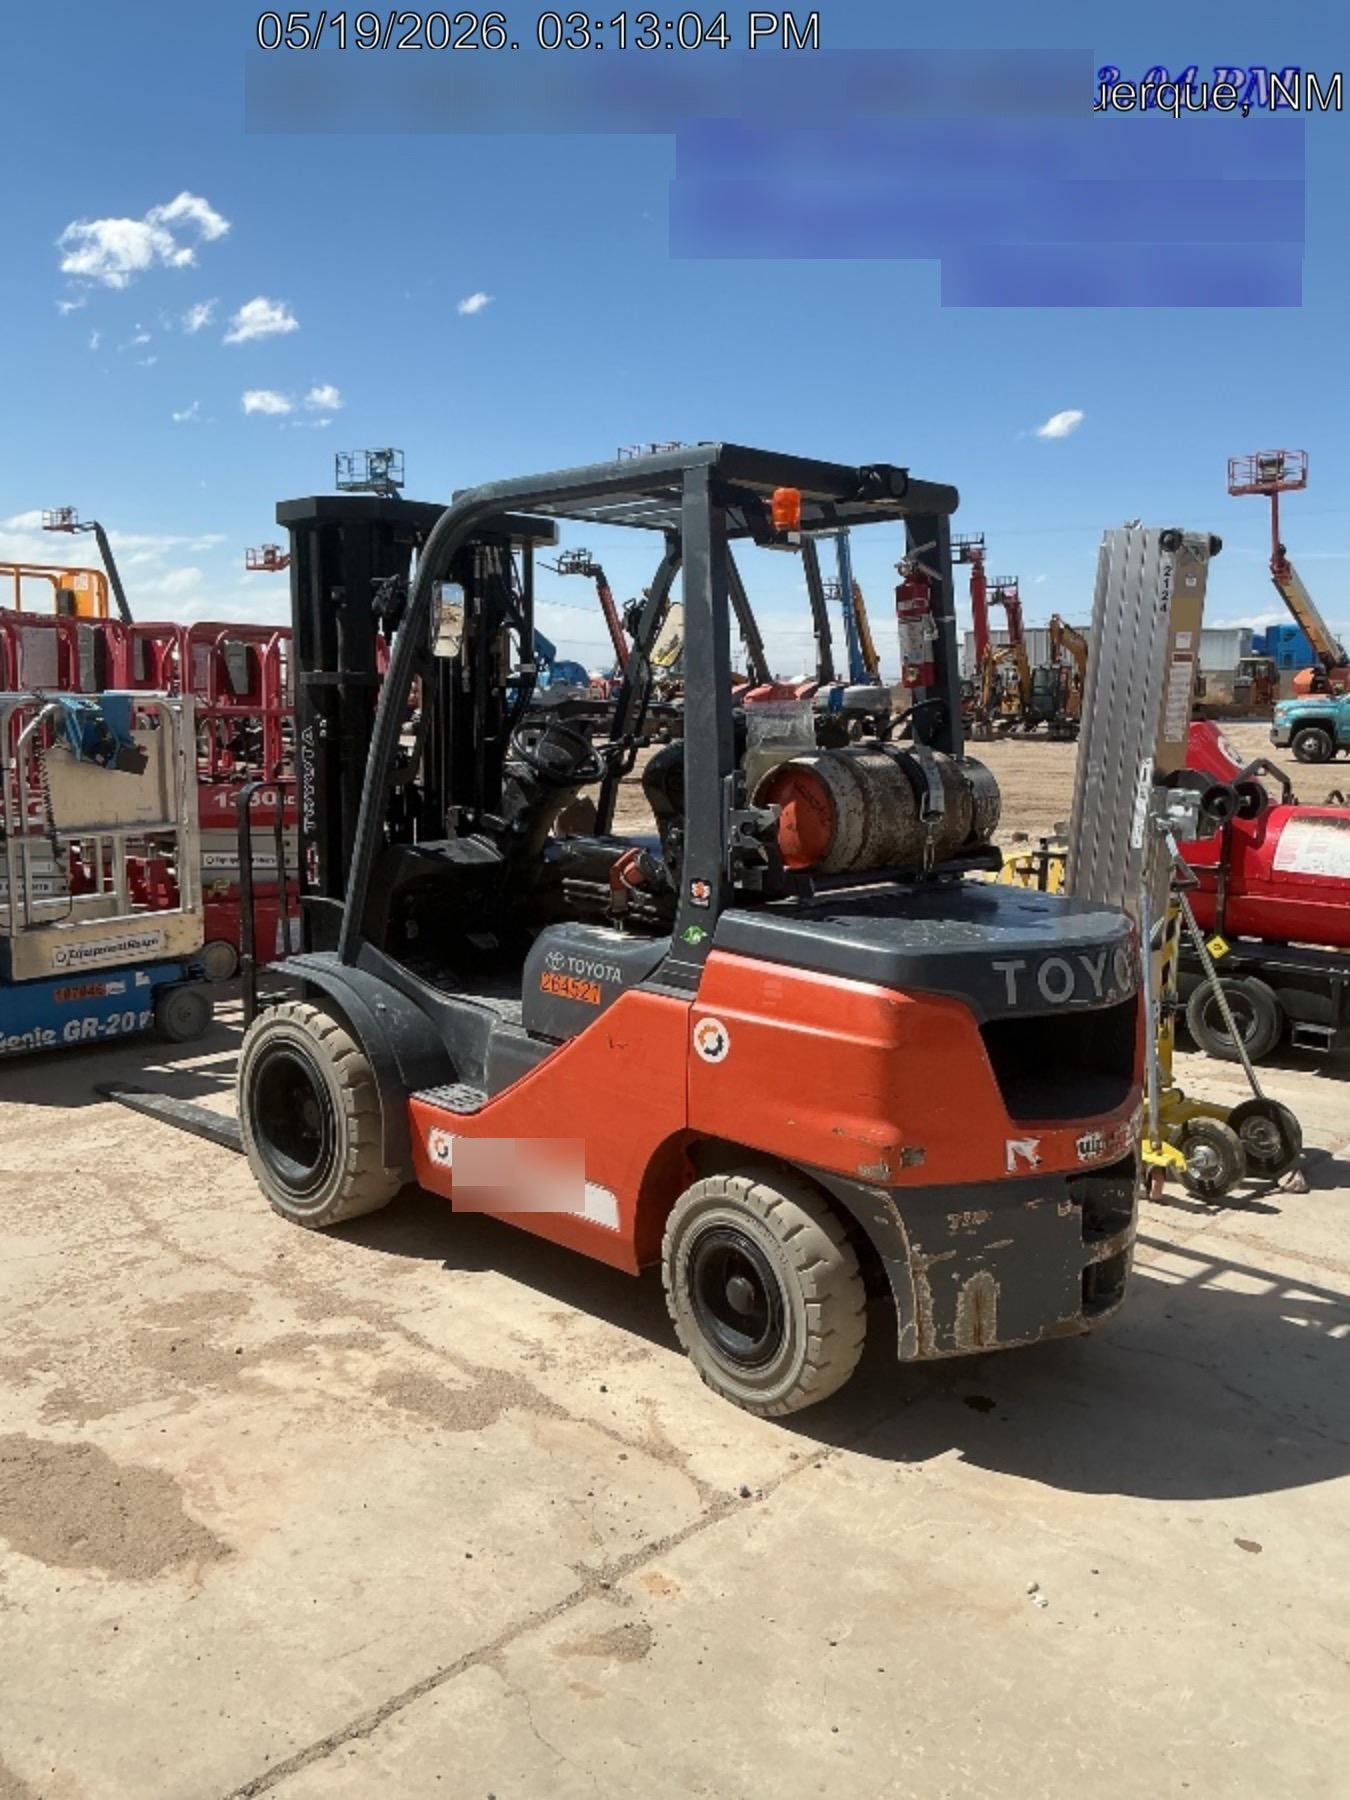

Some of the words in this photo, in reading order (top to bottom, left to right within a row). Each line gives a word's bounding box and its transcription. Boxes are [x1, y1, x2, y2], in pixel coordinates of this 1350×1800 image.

[1159, 564, 1173, 614] 2124
[567, 956, 623, 985] TOYOTA
[541, 971, 600, 1003] 264521
